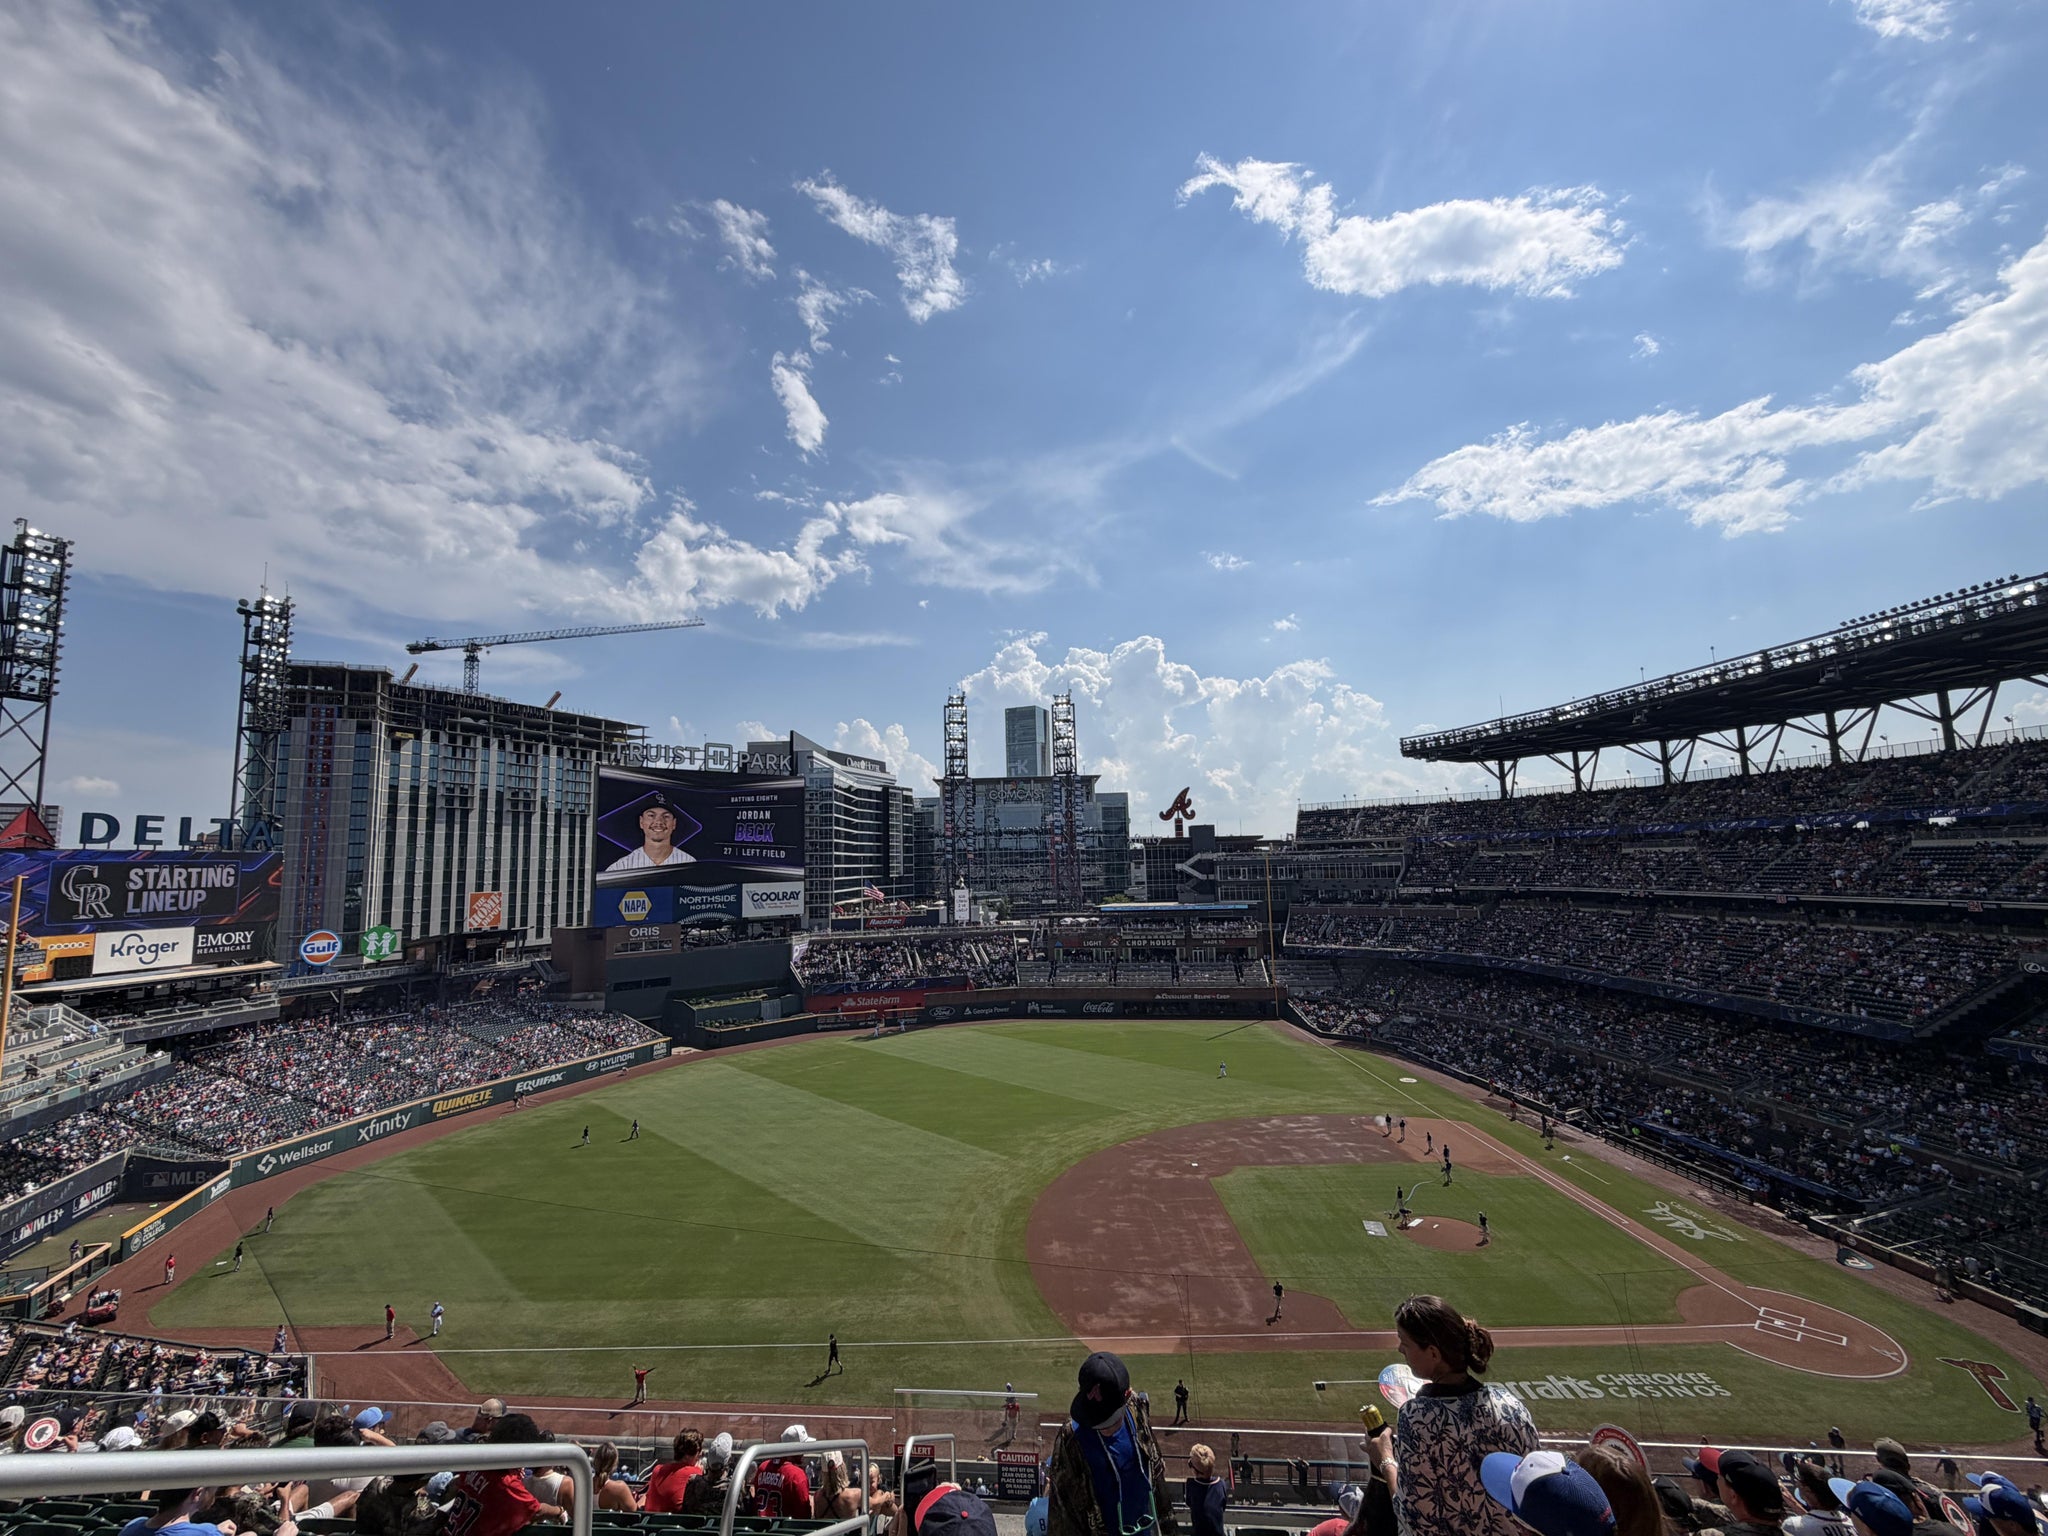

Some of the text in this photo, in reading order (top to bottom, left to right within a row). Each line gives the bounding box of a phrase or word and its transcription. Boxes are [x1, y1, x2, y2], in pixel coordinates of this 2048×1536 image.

[612, 742, 792, 771] TRUIST PARK
[730, 794, 778, 803] BATTING EIGHTH
[736, 810, 771, 820] JORDAN
[79, 812, 274, 850] DELTA
[734, 822, 775, 843] BECK
[723, 847, 786, 859] 27 LEFT FIELD
[128, 866, 236, 890] STARTING
[127, 890, 206, 914] LINEUP
[472, 896, 487, 910] THE
[679, 894, 737, 905] NORTHSIDE
[751, 890, 801, 903] COOLRAY
[470, 892, 500, 926] HOME
[624, 899, 647, 913] NAPA
[482, 904, 501, 926] DEPOT
[198, 931, 255, 948] EMORY
[629, 927, 660, 937] ORIS
[110, 933, 180, 965] Kroger
[197, 944, 251, 955] HEALTHCARE
[303, 940, 339, 954] Gulf
[934, 1007, 951, 1016] Ford
[972, 1007, 993, 1015] Georgia
[600, 1052, 635, 1068] HYUNDAI
[515, 1072, 565, 1092] EQUIFAX
[432, 1089, 493, 1114] QUIKRETE
[357, 1112, 412, 1142] xfinity
[279, 1140, 334, 1166] Wellstar
[90, 1179, 118, 1204] MLB+
[142, 1222, 166, 1243] COLLEGE
[143, 1217, 163, 1235] SOUTH
[1595, 1372, 1716, 1387] CHEROKEE
[1607, 1384, 1733, 1399] CASINOS
[1000, 1453, 1036, 1463] CAUTION
